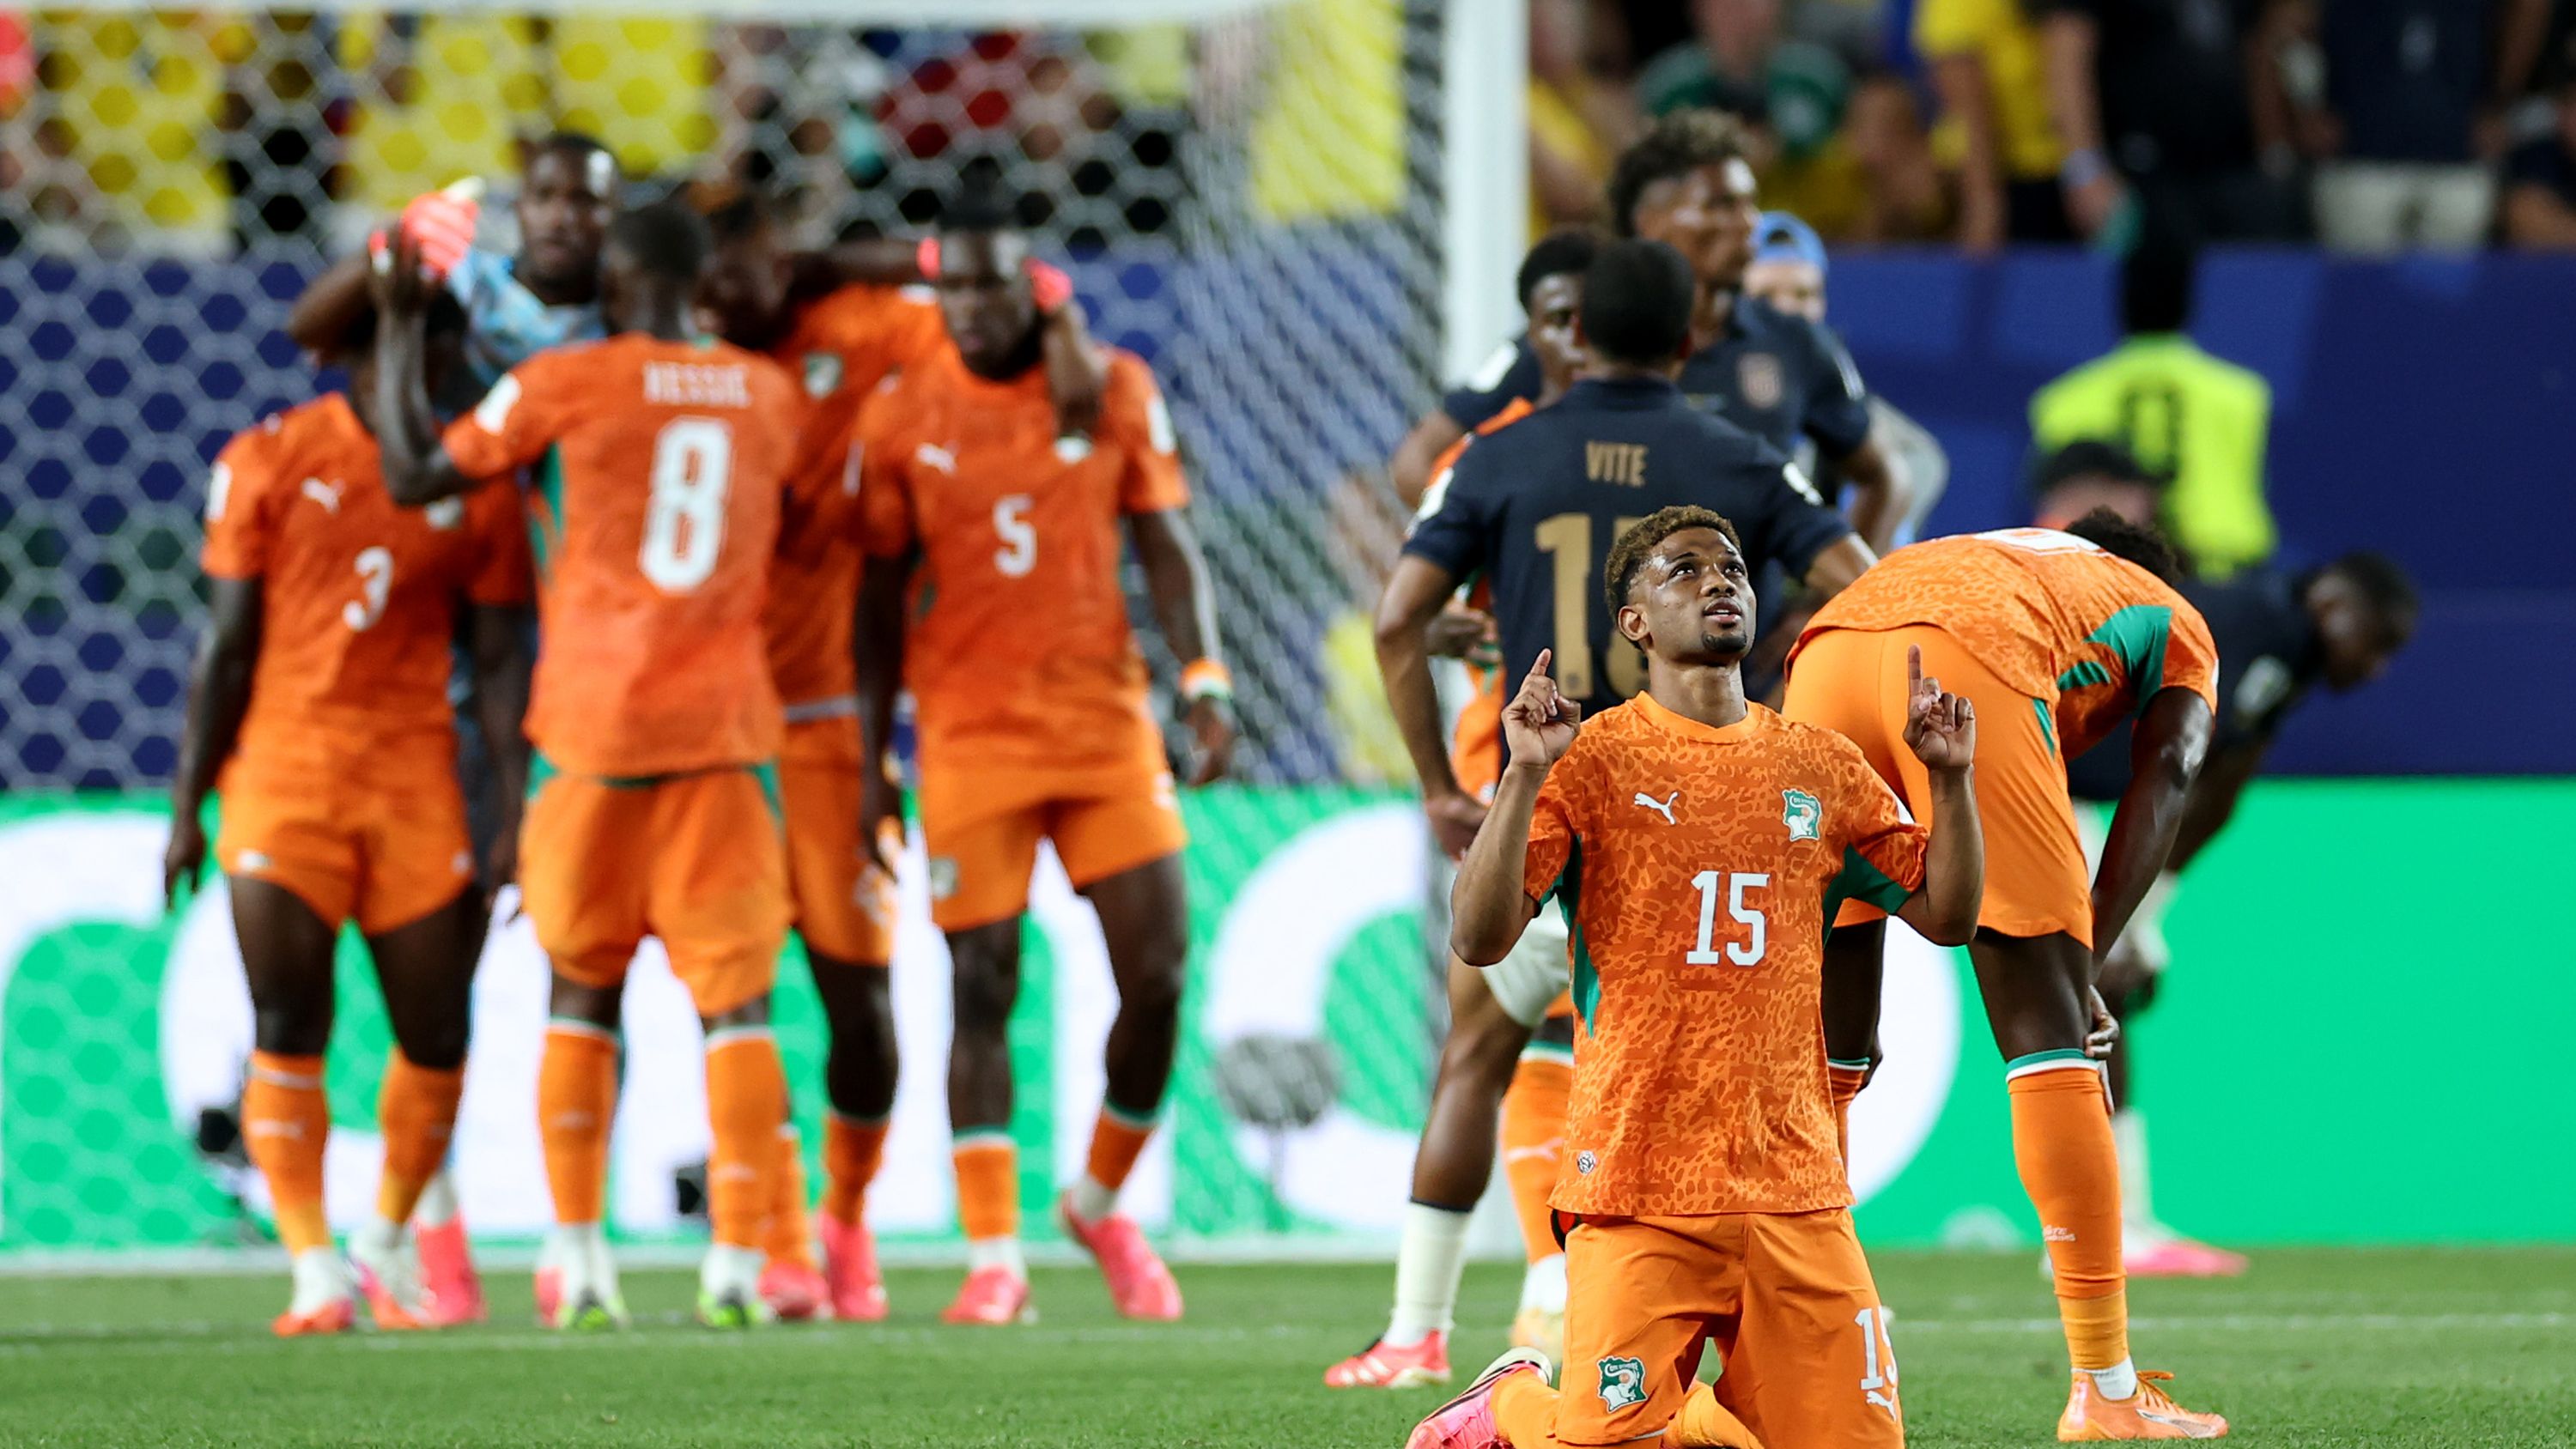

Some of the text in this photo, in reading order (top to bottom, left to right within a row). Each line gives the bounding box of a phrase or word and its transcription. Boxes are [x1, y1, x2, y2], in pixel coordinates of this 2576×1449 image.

[640, 415, 732, 594] 8
[1586, 440, 1649, 488] VITE
[993, 494, 1037, 578] 5
[342, 546, 393, 632] 3
[1686, 870, 1771, 967] 15
